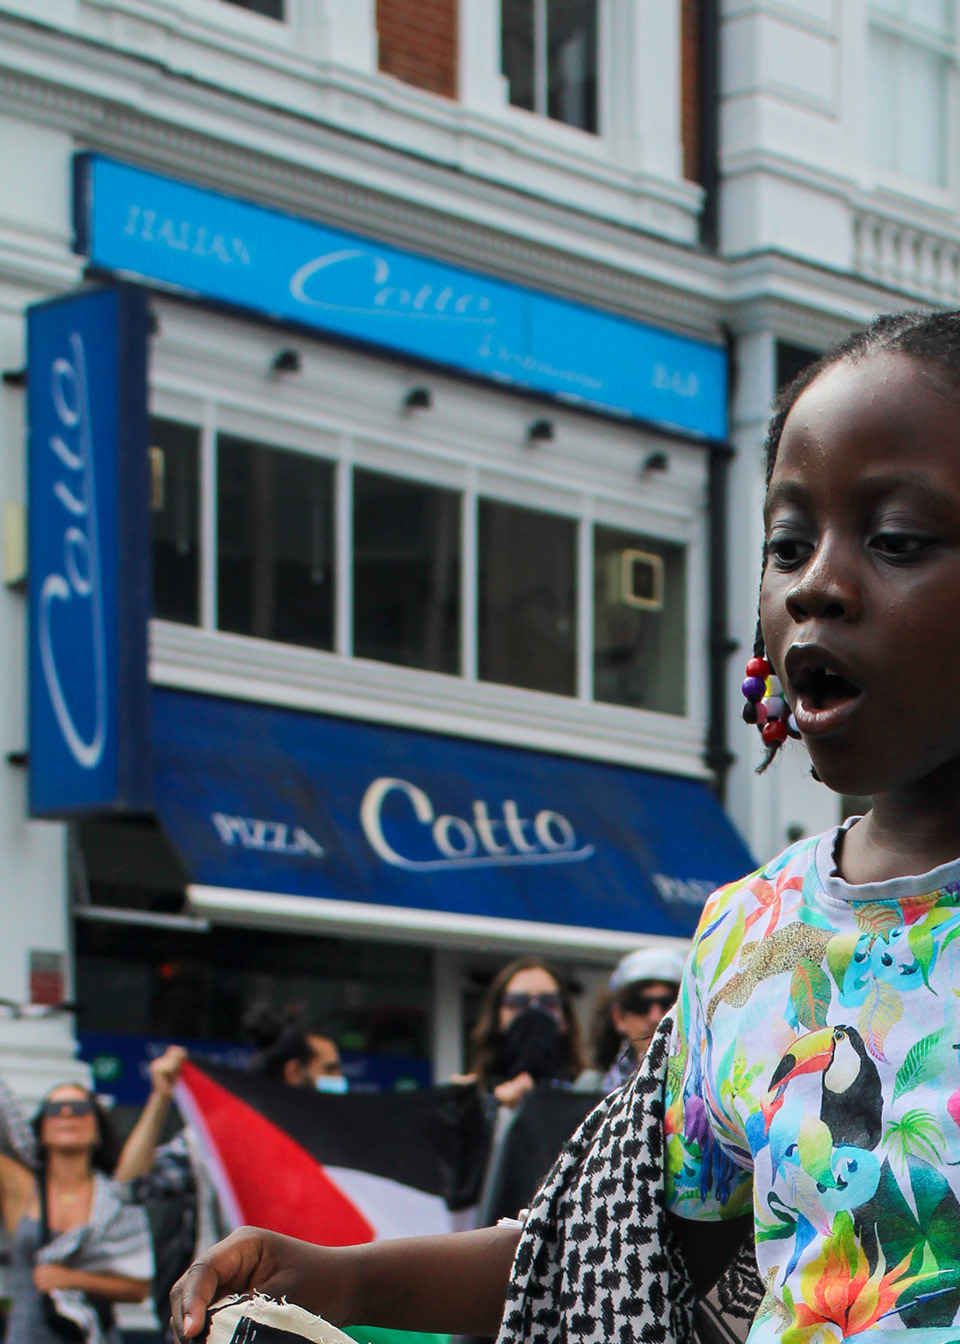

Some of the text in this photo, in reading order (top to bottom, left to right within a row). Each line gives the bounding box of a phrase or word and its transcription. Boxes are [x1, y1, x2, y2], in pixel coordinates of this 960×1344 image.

[125, 204, 251, 265] ITALIAN
[211, 811, 325, 858] PIZZA
[360, 776, 595, 872] Cotto
